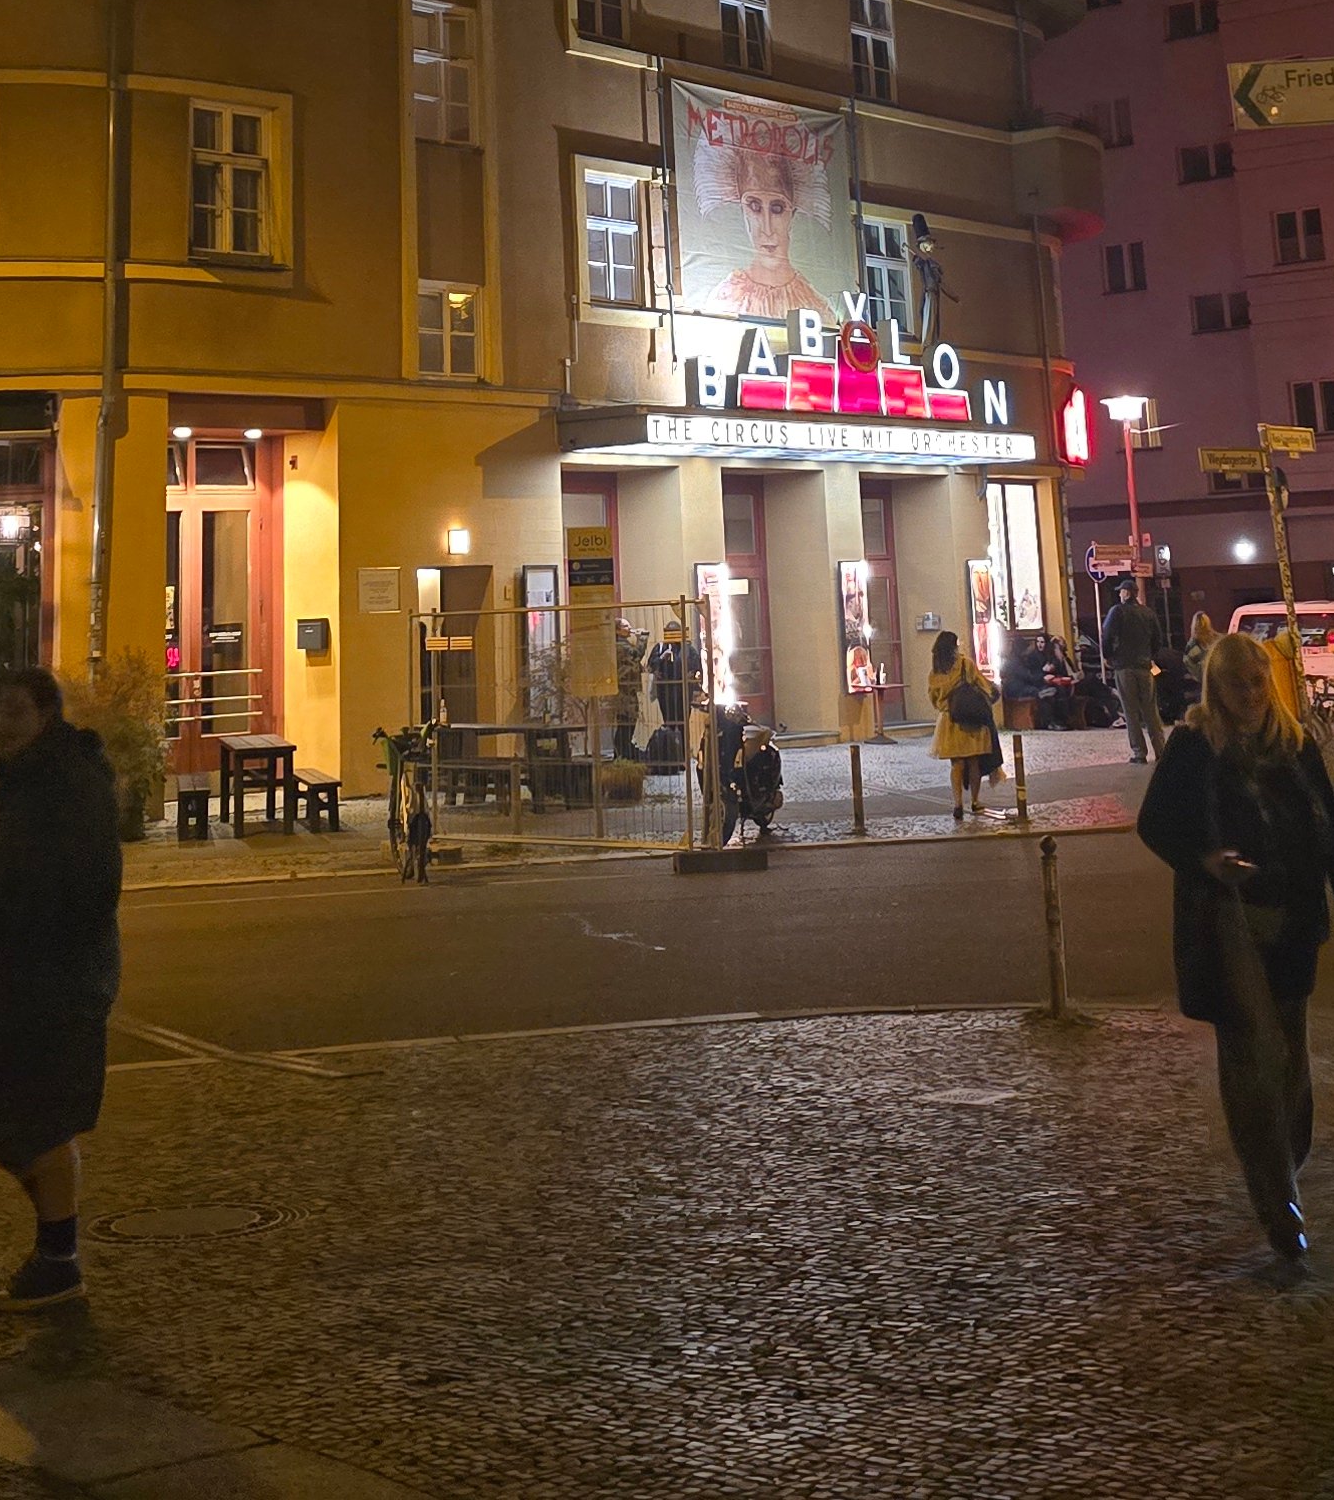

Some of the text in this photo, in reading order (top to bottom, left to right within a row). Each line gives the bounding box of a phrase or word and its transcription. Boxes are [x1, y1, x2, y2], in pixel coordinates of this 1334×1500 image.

[687, 97, 834, 171] METROPOLIS
[697, 290, 1009, 425] BABYLON
[652, 419, 693, 441] THE
[711, 422, 789, 445] CIRCUS
[808, 426, 849, 448] LIVE
[862, 429, 894, 450] MIT
[573, 534, 607, 547] Jelbi
